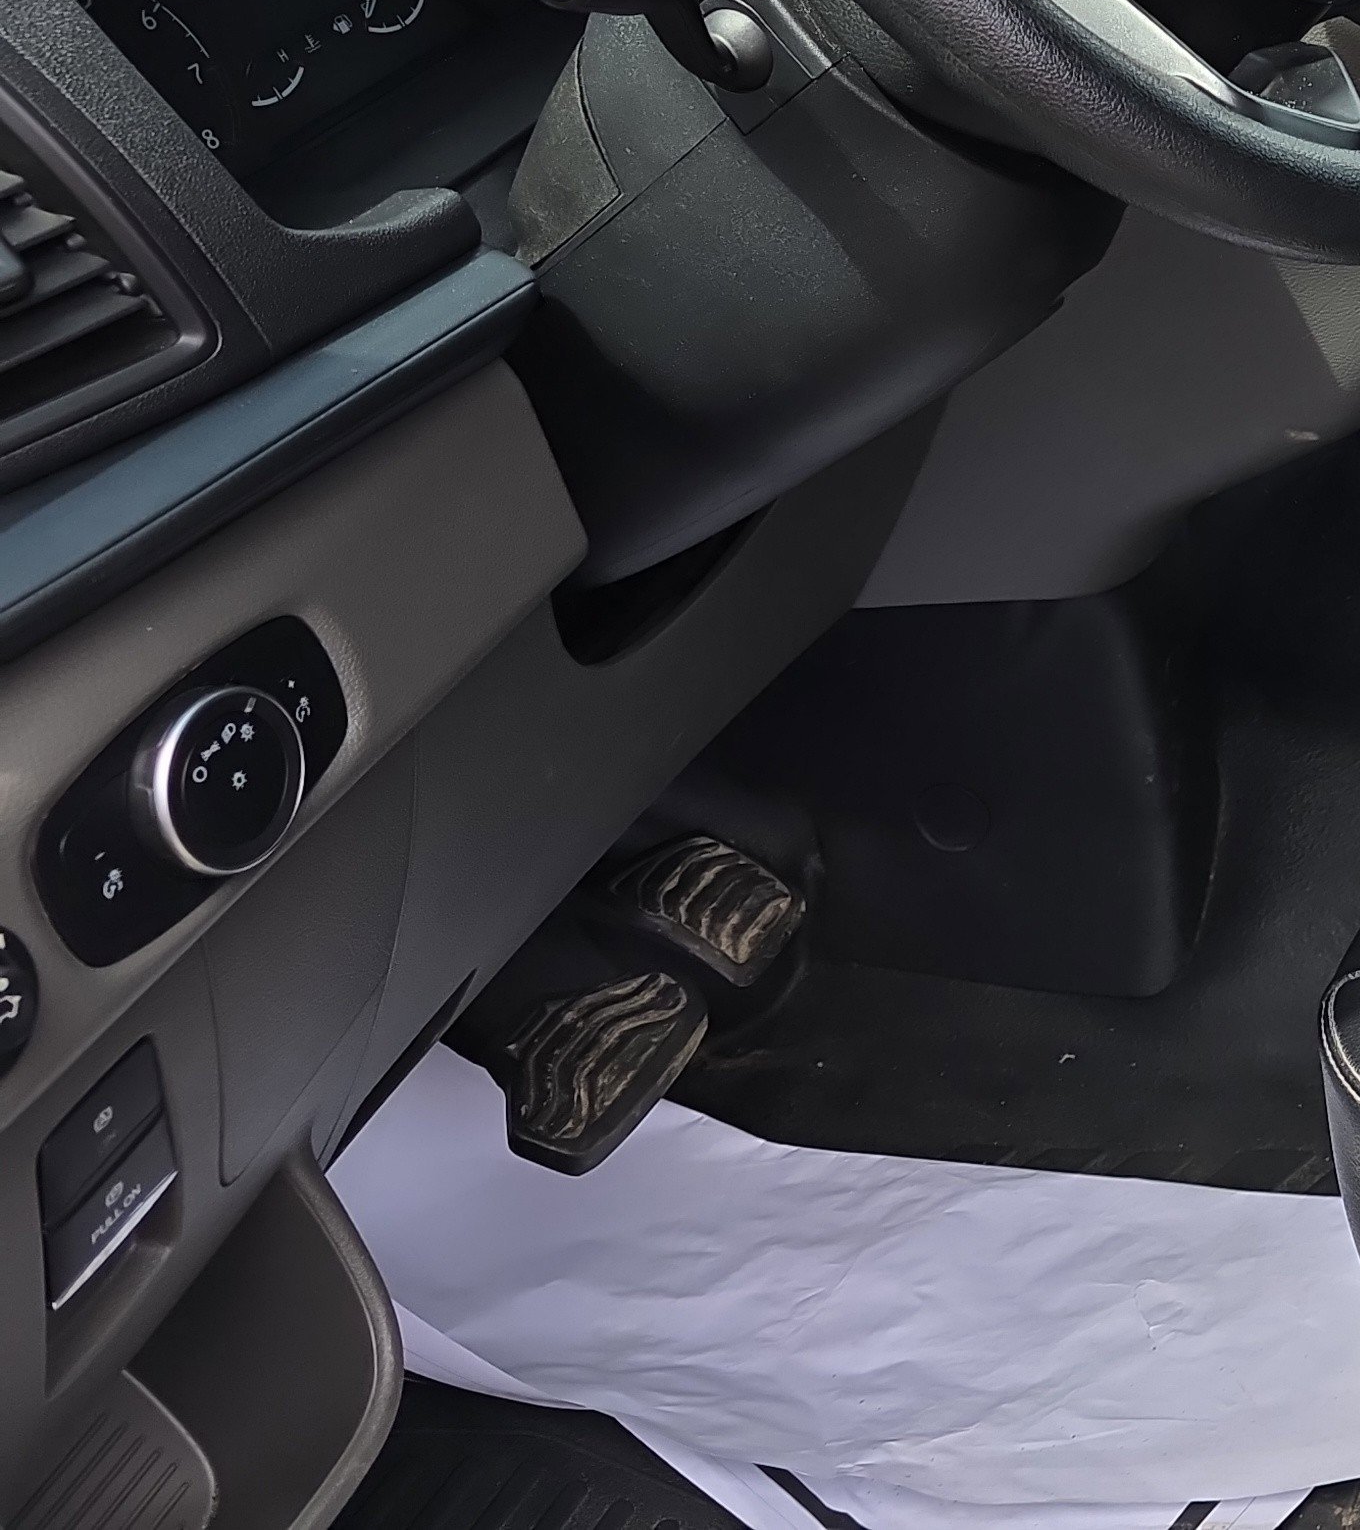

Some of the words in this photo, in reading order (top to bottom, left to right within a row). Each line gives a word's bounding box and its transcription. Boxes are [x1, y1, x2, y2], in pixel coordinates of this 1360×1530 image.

[141, 9, 158, 30] 6
[276, 48, 290, 64] H
[187, 62, 203, 85] 7
[201, 128, 221, 150] 8
[91, 1208, 125, 1245] PULL
[123, 1183, 142, 1208] ON
